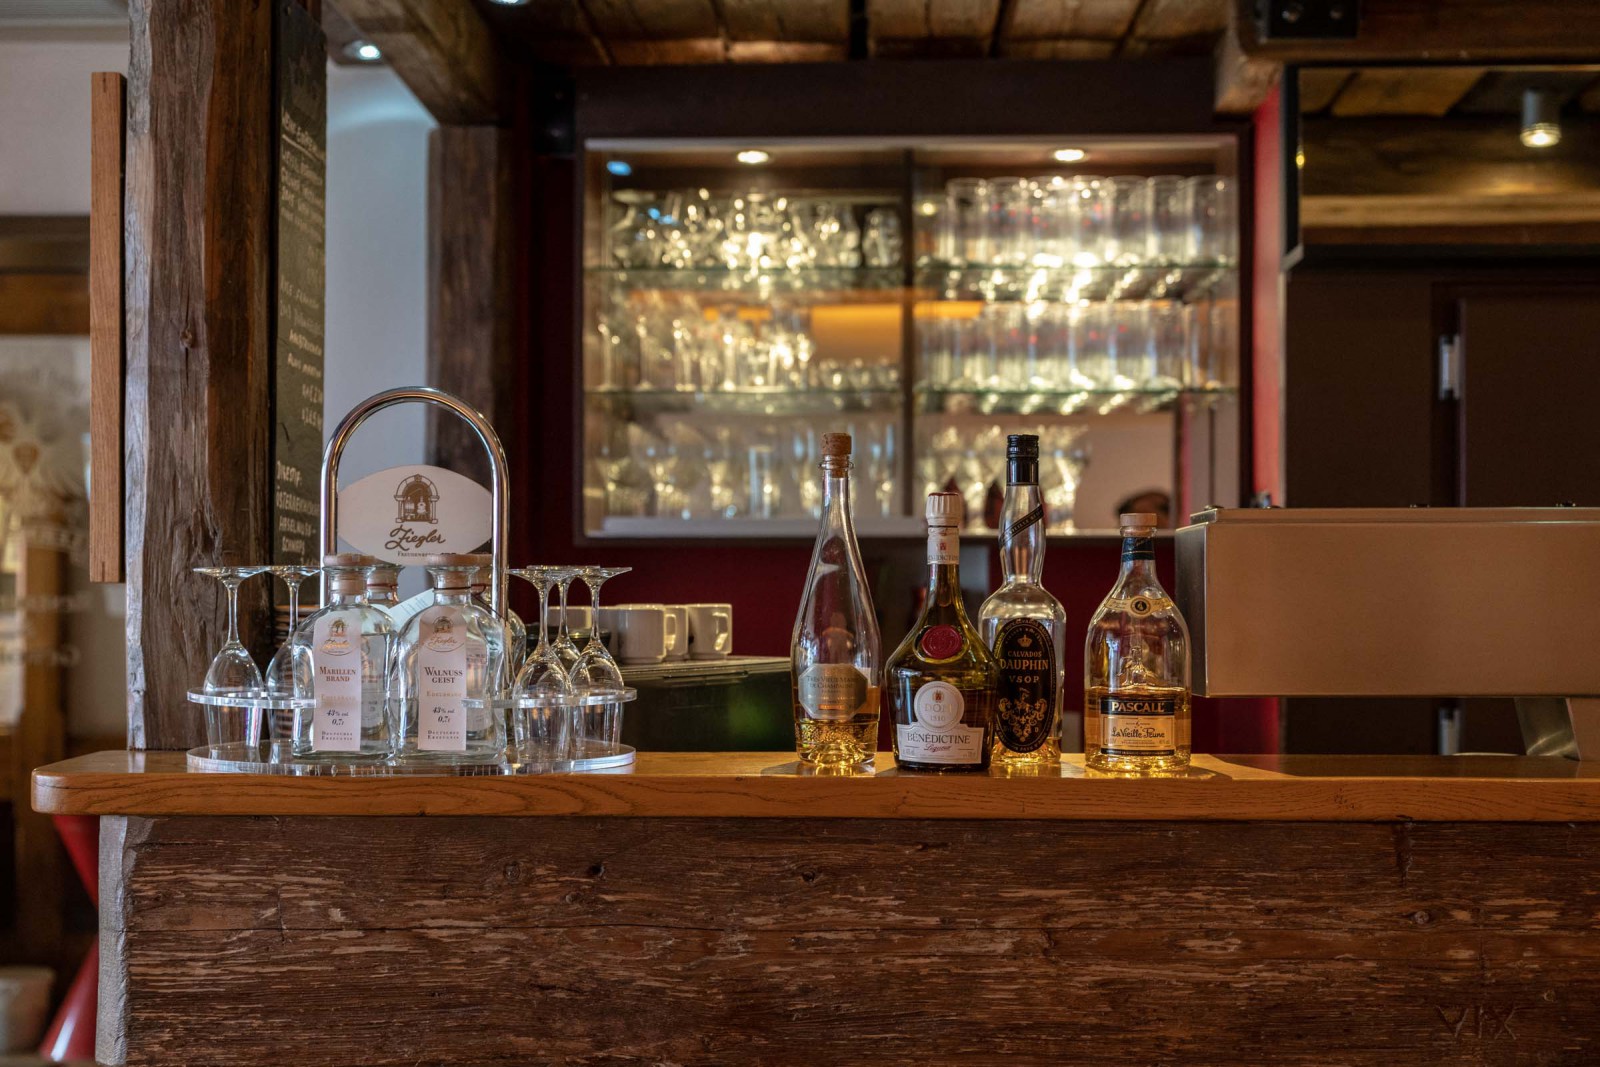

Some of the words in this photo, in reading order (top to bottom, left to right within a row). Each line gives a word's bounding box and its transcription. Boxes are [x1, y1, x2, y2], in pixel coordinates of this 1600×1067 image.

[385, 524, 446, 551] Ziegler
[1000, 659, 1049, 670] DAUPHIN
[320, 667, 356, 675] MARILLEN
[424, 667, 463, 676] WALNUSS
[1008, 675, 1040, 684] VSOP
[907, 731, 971, 744] BÉNÉDICTINE
